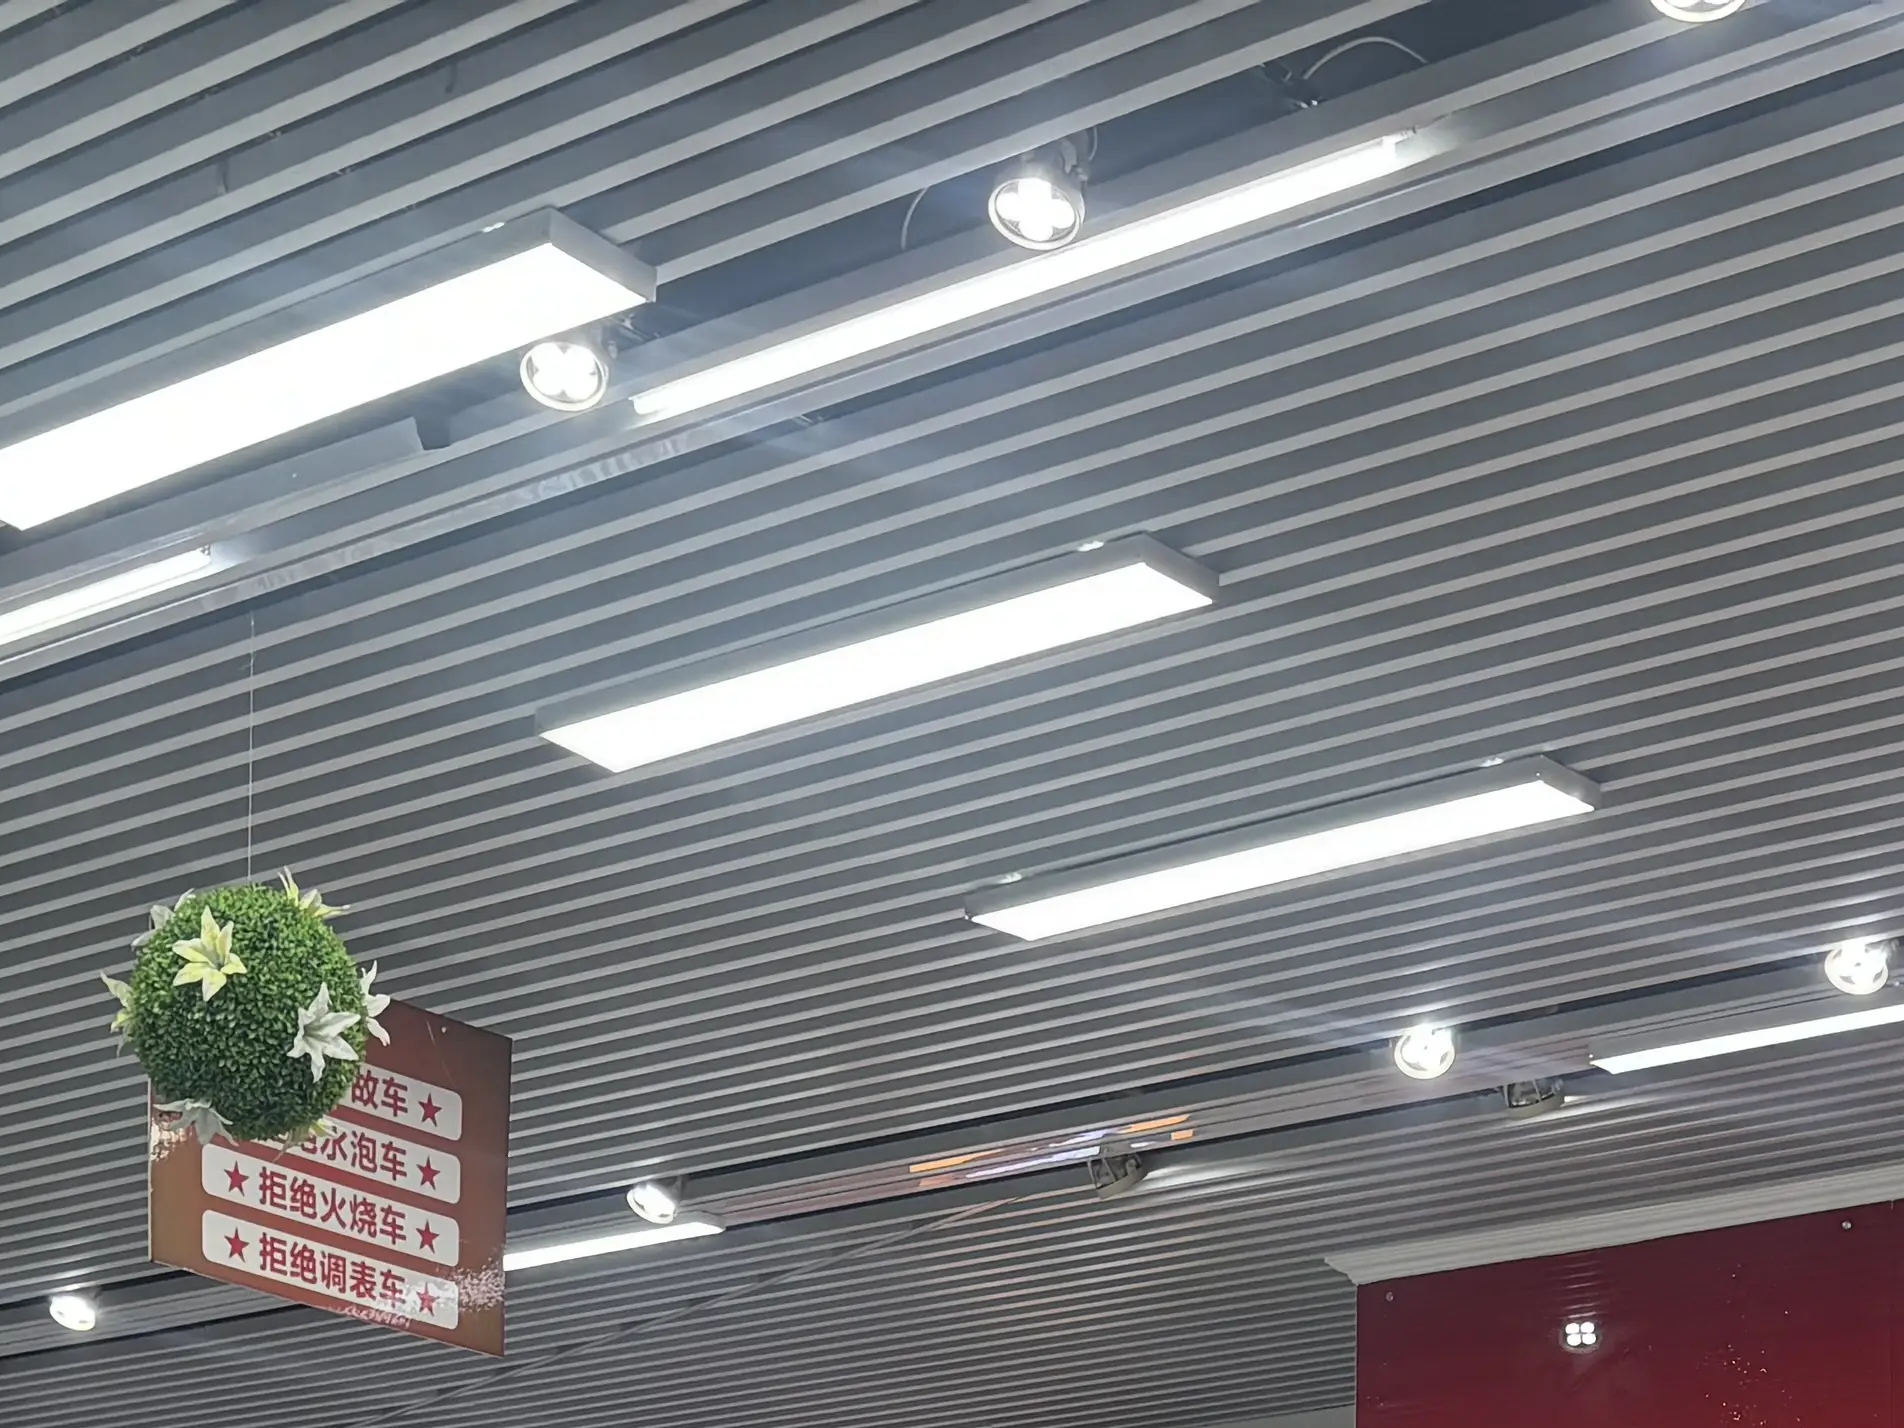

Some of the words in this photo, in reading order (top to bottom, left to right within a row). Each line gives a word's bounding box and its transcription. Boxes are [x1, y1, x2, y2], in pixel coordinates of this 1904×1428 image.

[259, 1167, 407, 1245] 拒绝火烧车
[259, 1232, 406, 1309] 拒绝调表车
